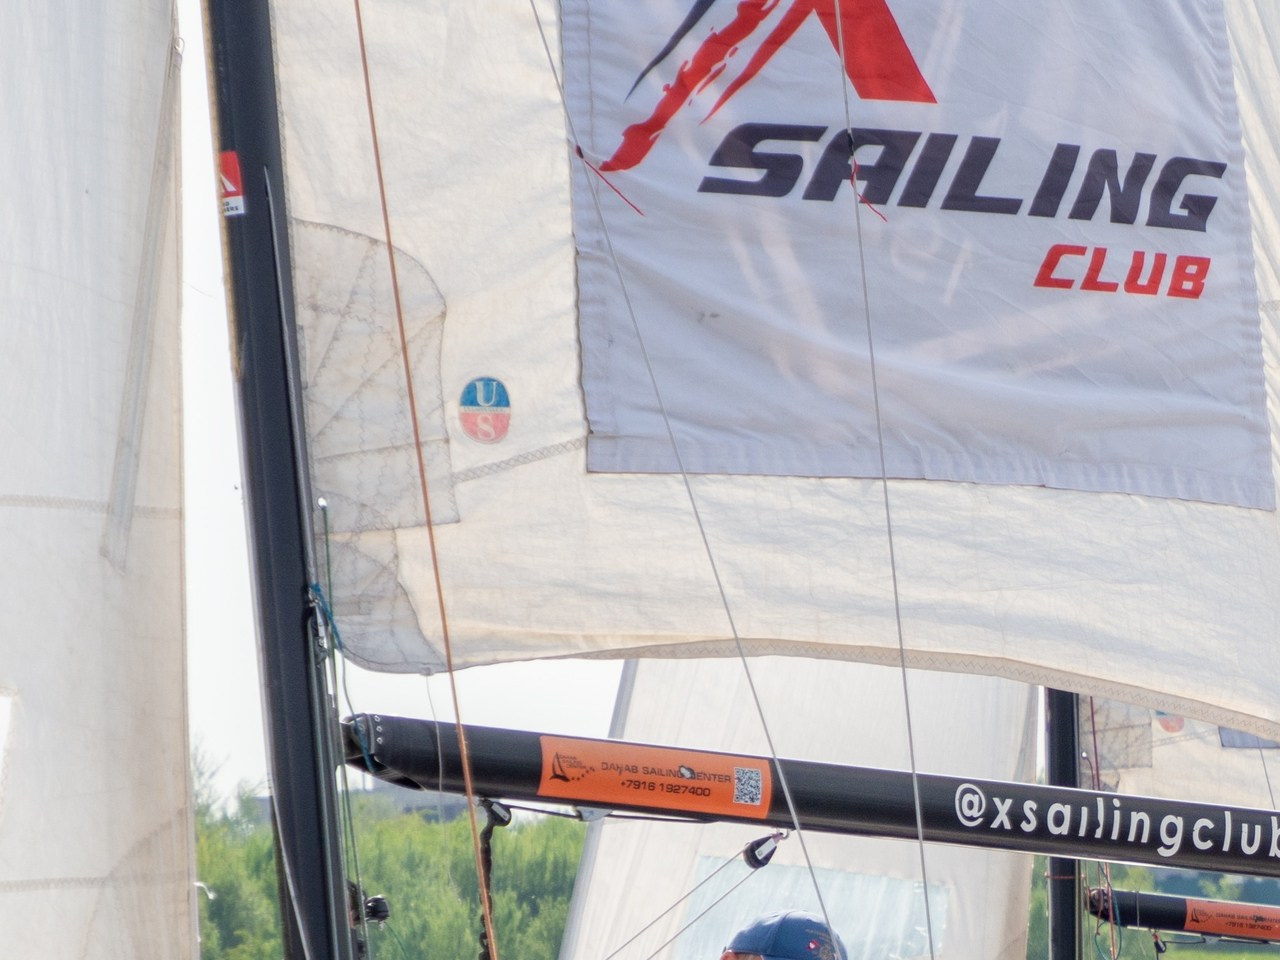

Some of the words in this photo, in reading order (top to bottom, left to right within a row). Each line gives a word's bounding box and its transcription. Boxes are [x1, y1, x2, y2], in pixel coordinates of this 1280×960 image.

[698, 122, 1227, 232] SAILING
[1033, 243, 1211, 299] CLUB
[621, 779, 656, 791] +7916
[659, 782, 711, 797] 1927400
[687, 770, 731, 783] ENTER
